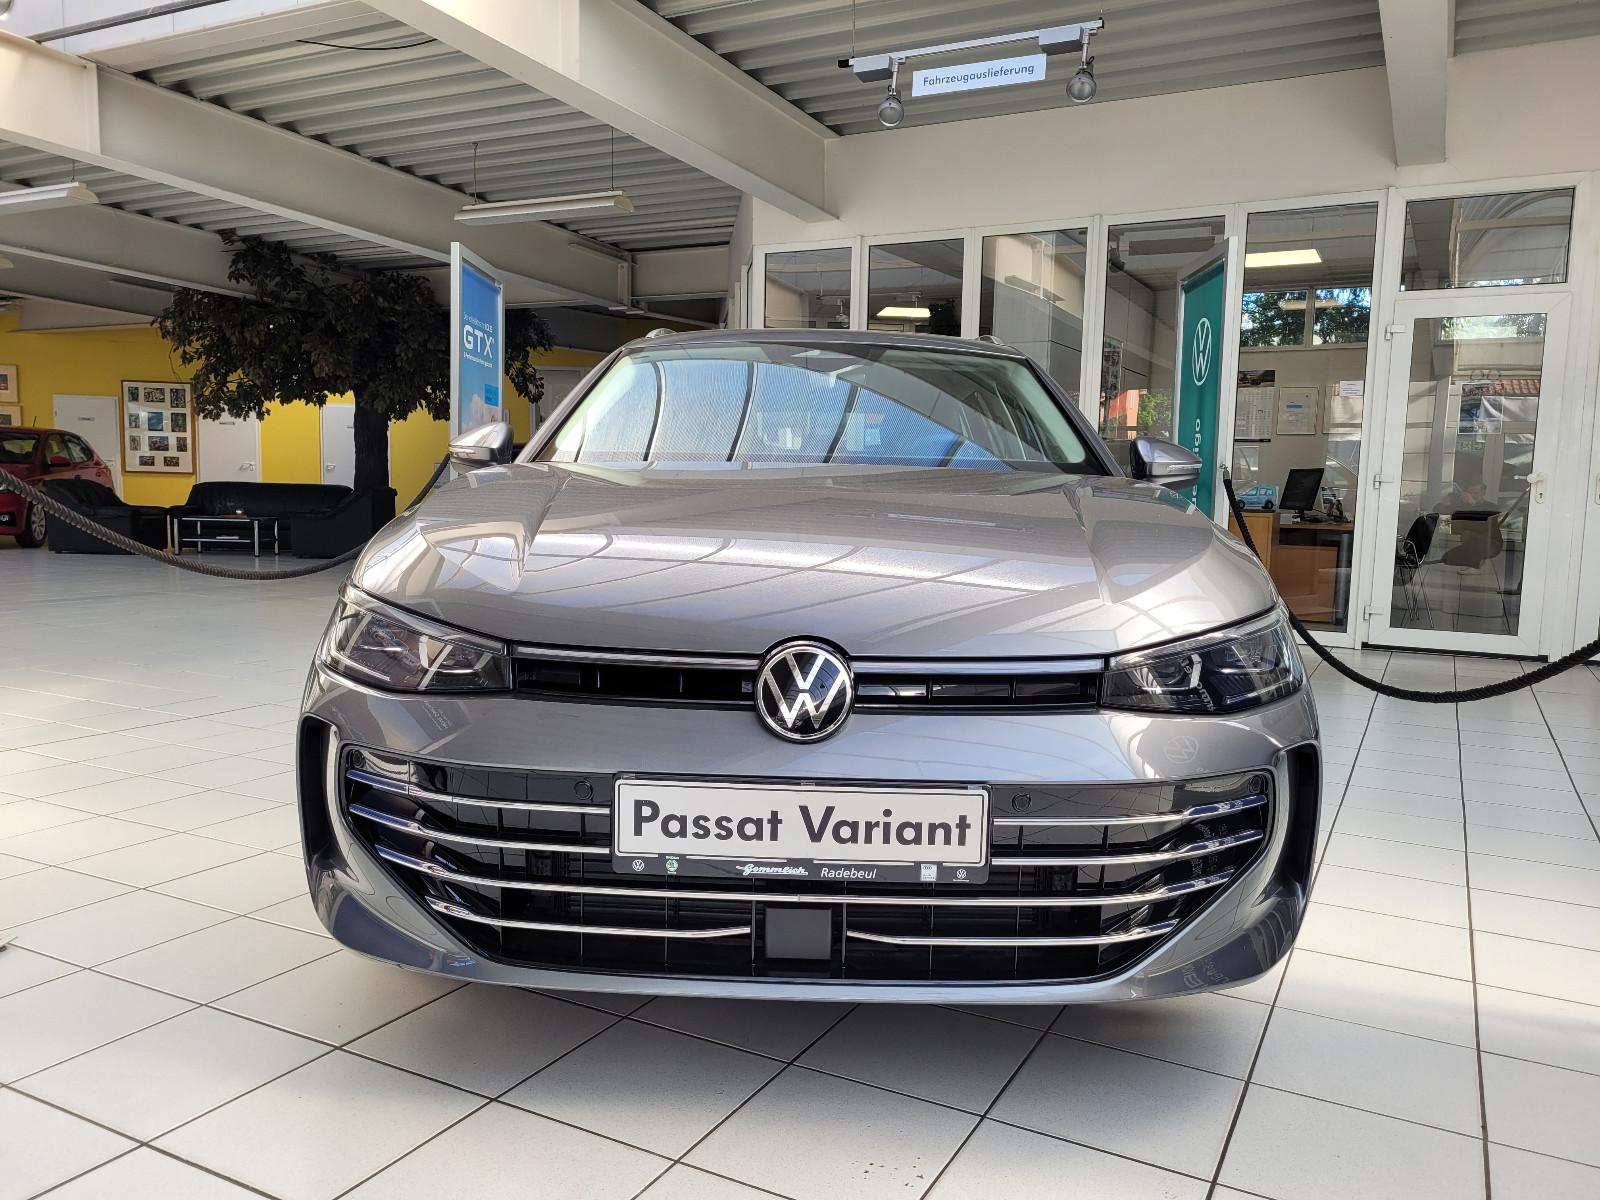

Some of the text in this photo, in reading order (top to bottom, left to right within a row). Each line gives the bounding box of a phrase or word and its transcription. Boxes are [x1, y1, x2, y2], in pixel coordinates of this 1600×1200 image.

[923, 64, 1035, 87] Fahrzeugauslieferung
[463, 324, 493, 359] GTX
[633, 799, 972, 847] Passat Variant
[820, 867, 877, 879] Radebeul
